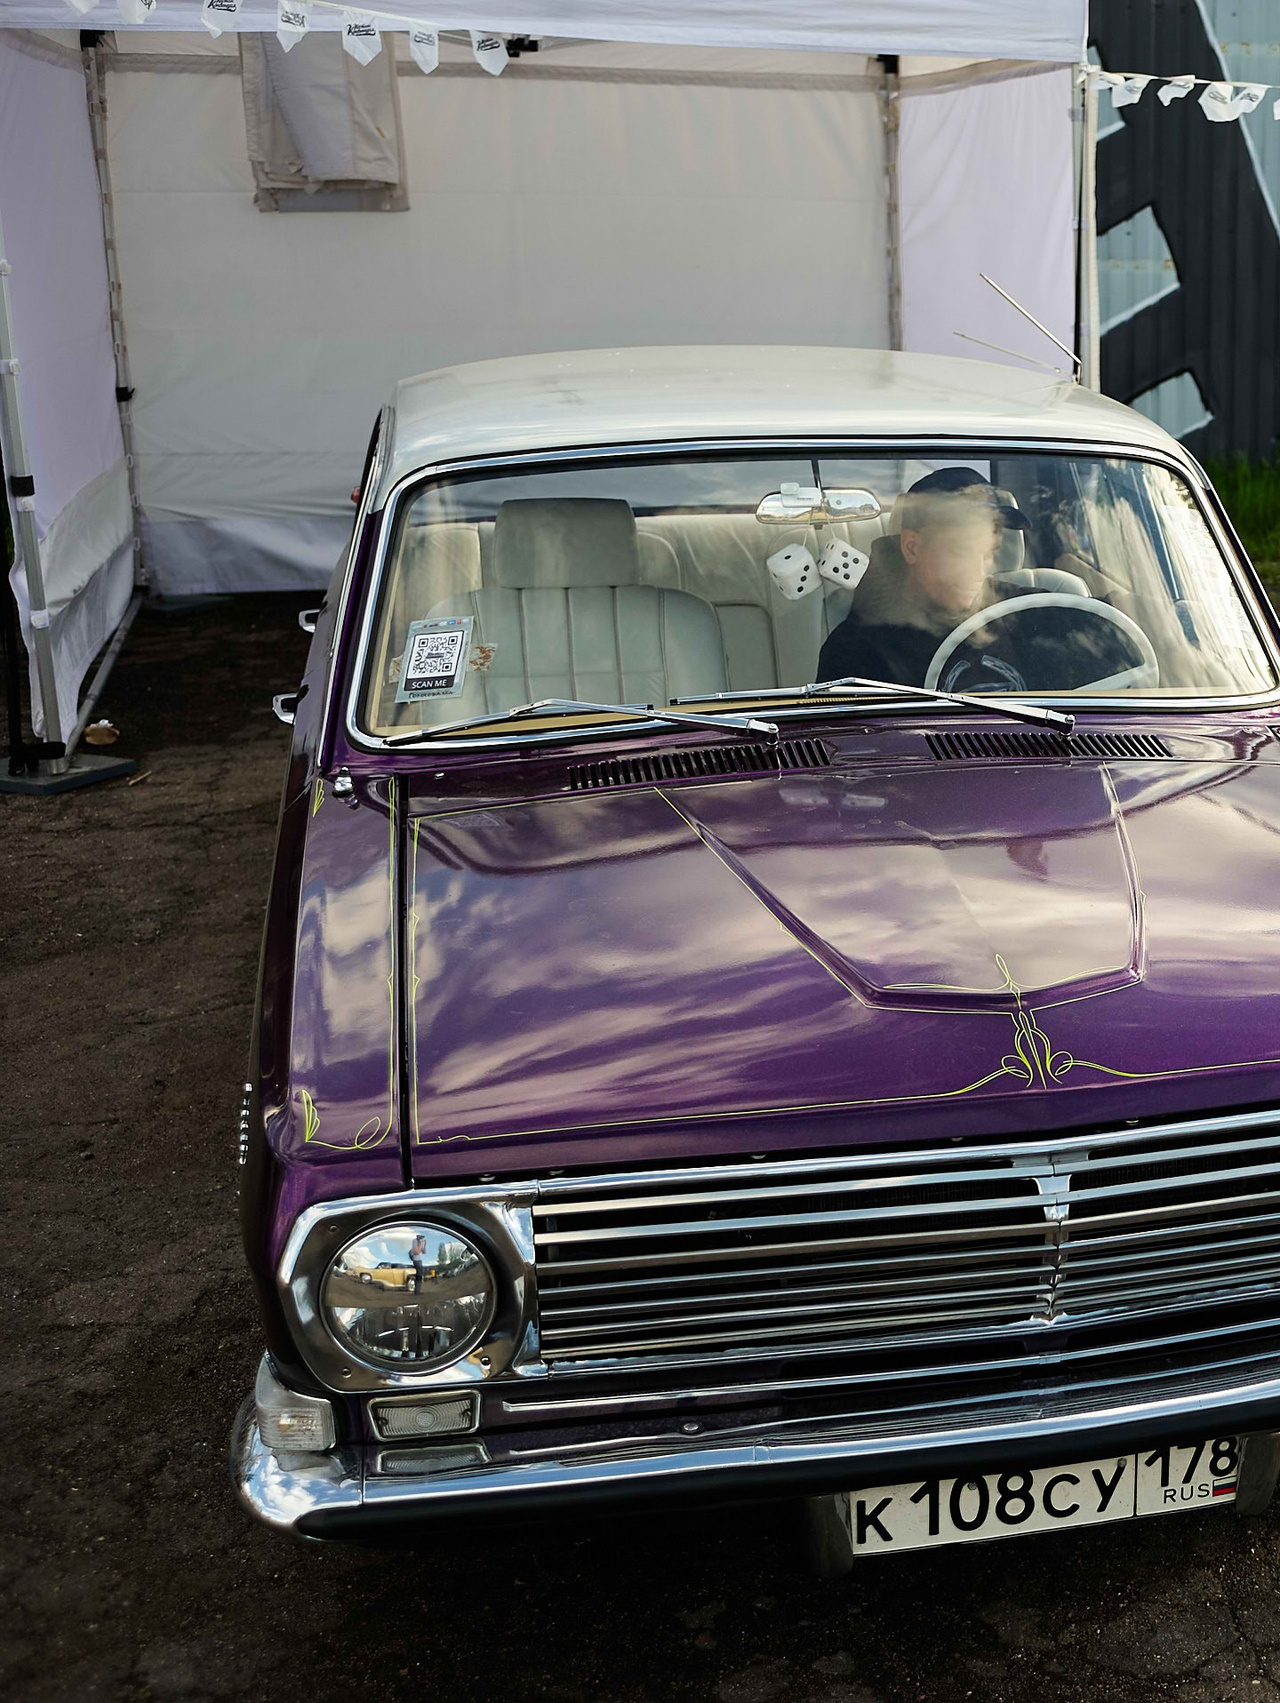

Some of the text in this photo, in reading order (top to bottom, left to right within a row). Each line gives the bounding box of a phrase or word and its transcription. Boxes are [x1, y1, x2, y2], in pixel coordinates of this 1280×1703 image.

[411, 679, 447, 689] SCAN ME
[1144, 1437, 1239, 1487] 178
[1163, 1483, 1210, 1504] RUS
